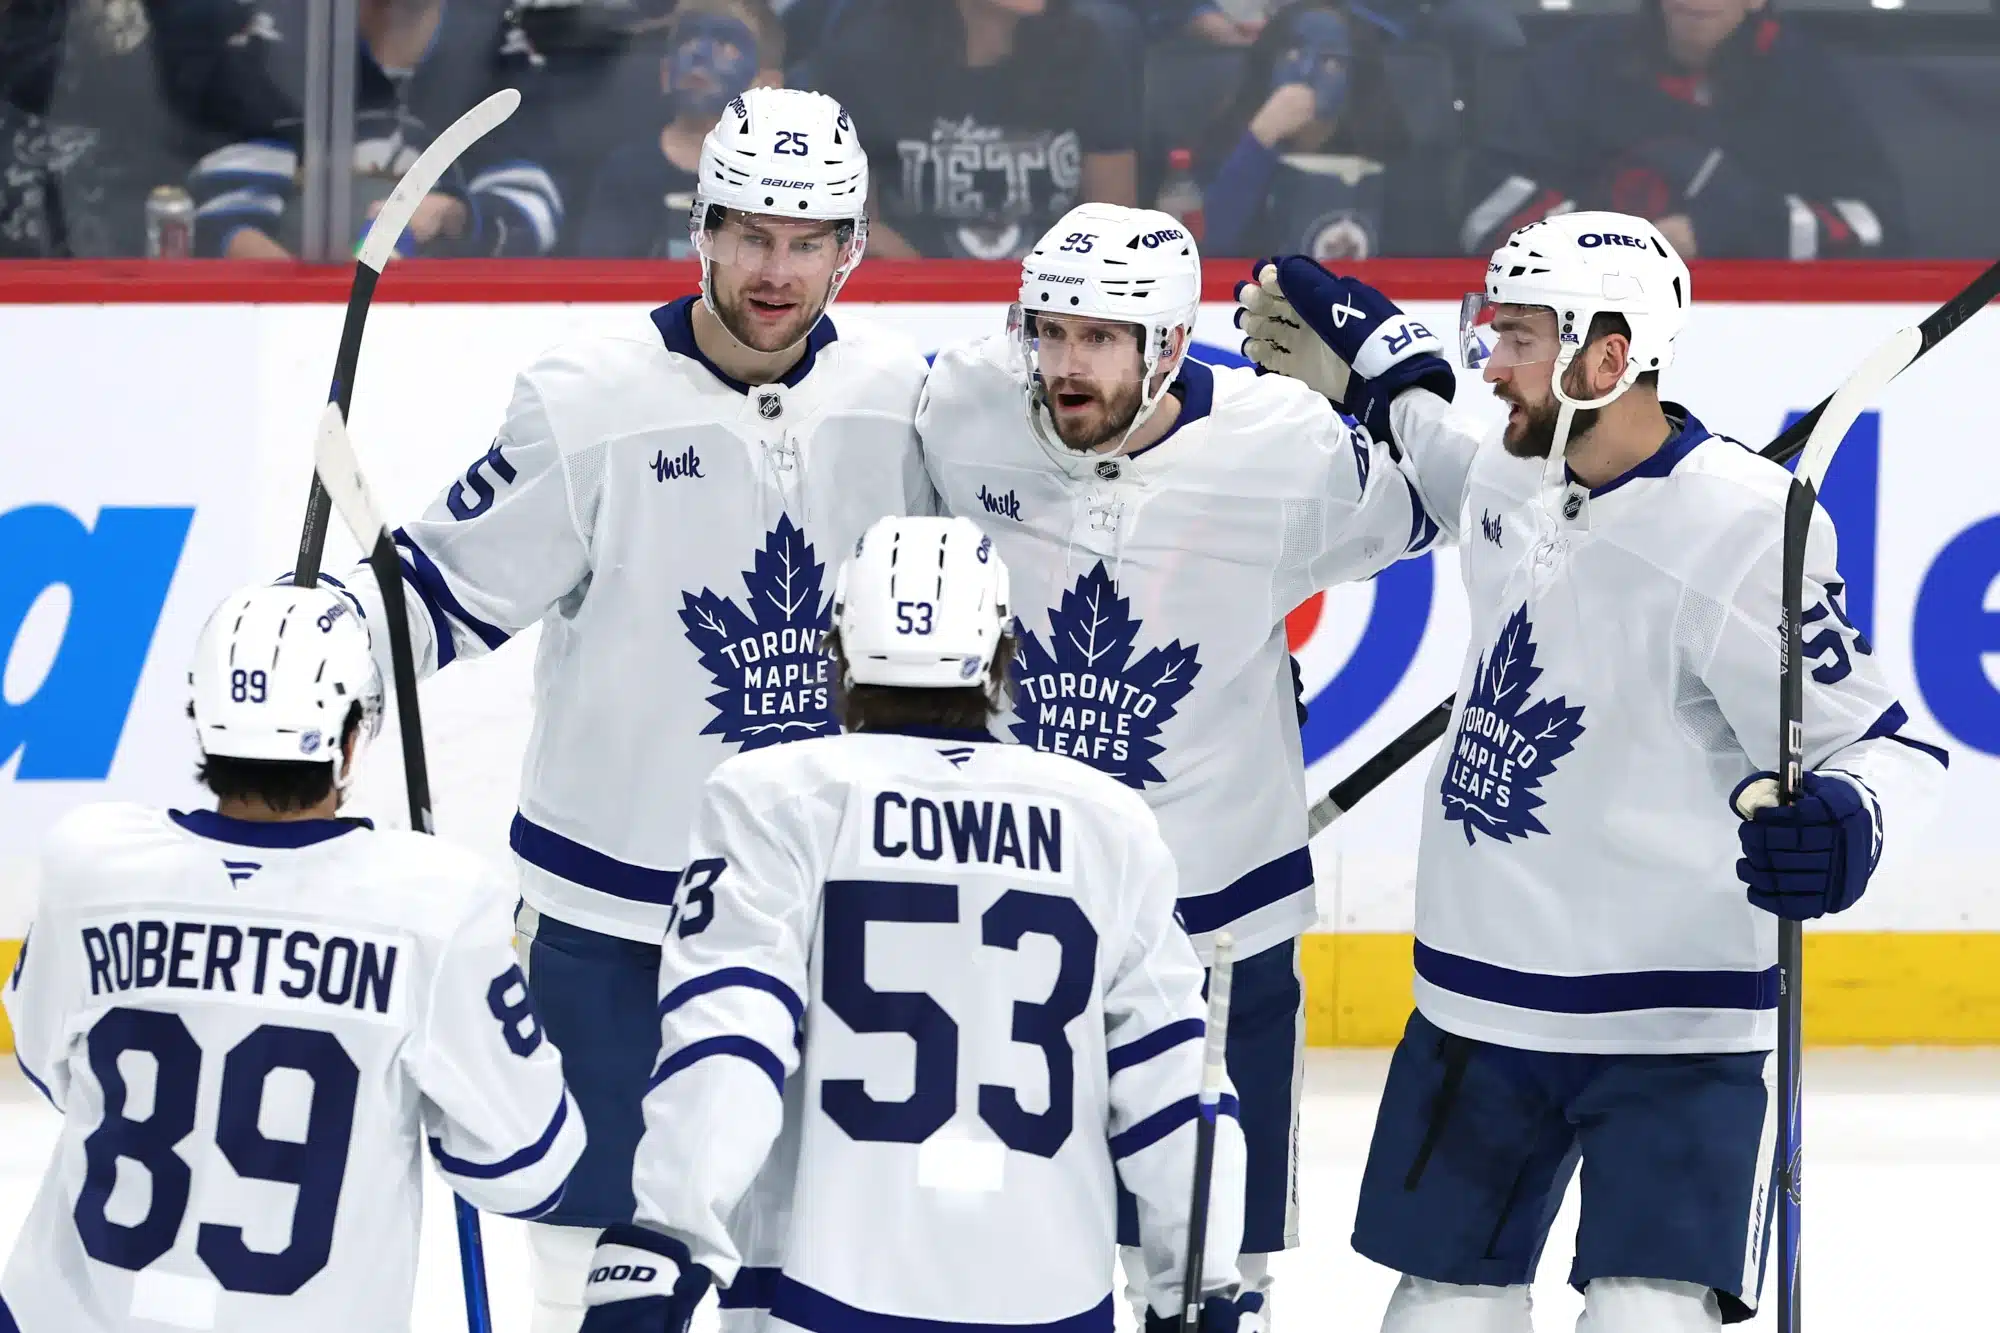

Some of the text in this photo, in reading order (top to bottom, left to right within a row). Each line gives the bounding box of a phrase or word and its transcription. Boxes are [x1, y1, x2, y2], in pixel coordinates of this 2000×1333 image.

[774, 131, 809, 156] 25
[760, 177, 815, 190] BAUER
[1060, 233, 1099, 253] 95
[1142, 229, 1183, 249] OREO
[1038, 273, 1085, 285] BAUER
[446, 437, 518, 522] 5
[649, 445, 706, 483] Milk
[975, 484, 1024, 522] Milk
[896, 601, 933, 635] 53
[231, 669, 267, 703] 89
[744, 659, 828, 689] MAPLE
[743, 688, 828, 716] LEAFS
[1020, 672, 1157, 719] TORONTO
[1039, 702, 1132, 736] MAPLE
[1460, 706, 1538, 769] TORONTO
[1037, 728, 1129, 761] LEAFS
[1458, 734, 1516, 783] MAPLE
[1451, 760, 1511, 808] LEAFS
[872, 790, 1061, 874] COWAN
[662, 857, 728, 940] 3
[81, 920, 398, 1014] ROBERTSON
[821, 879, 1098, 1159] 53
[73, 1006, 361, 1297] 89
